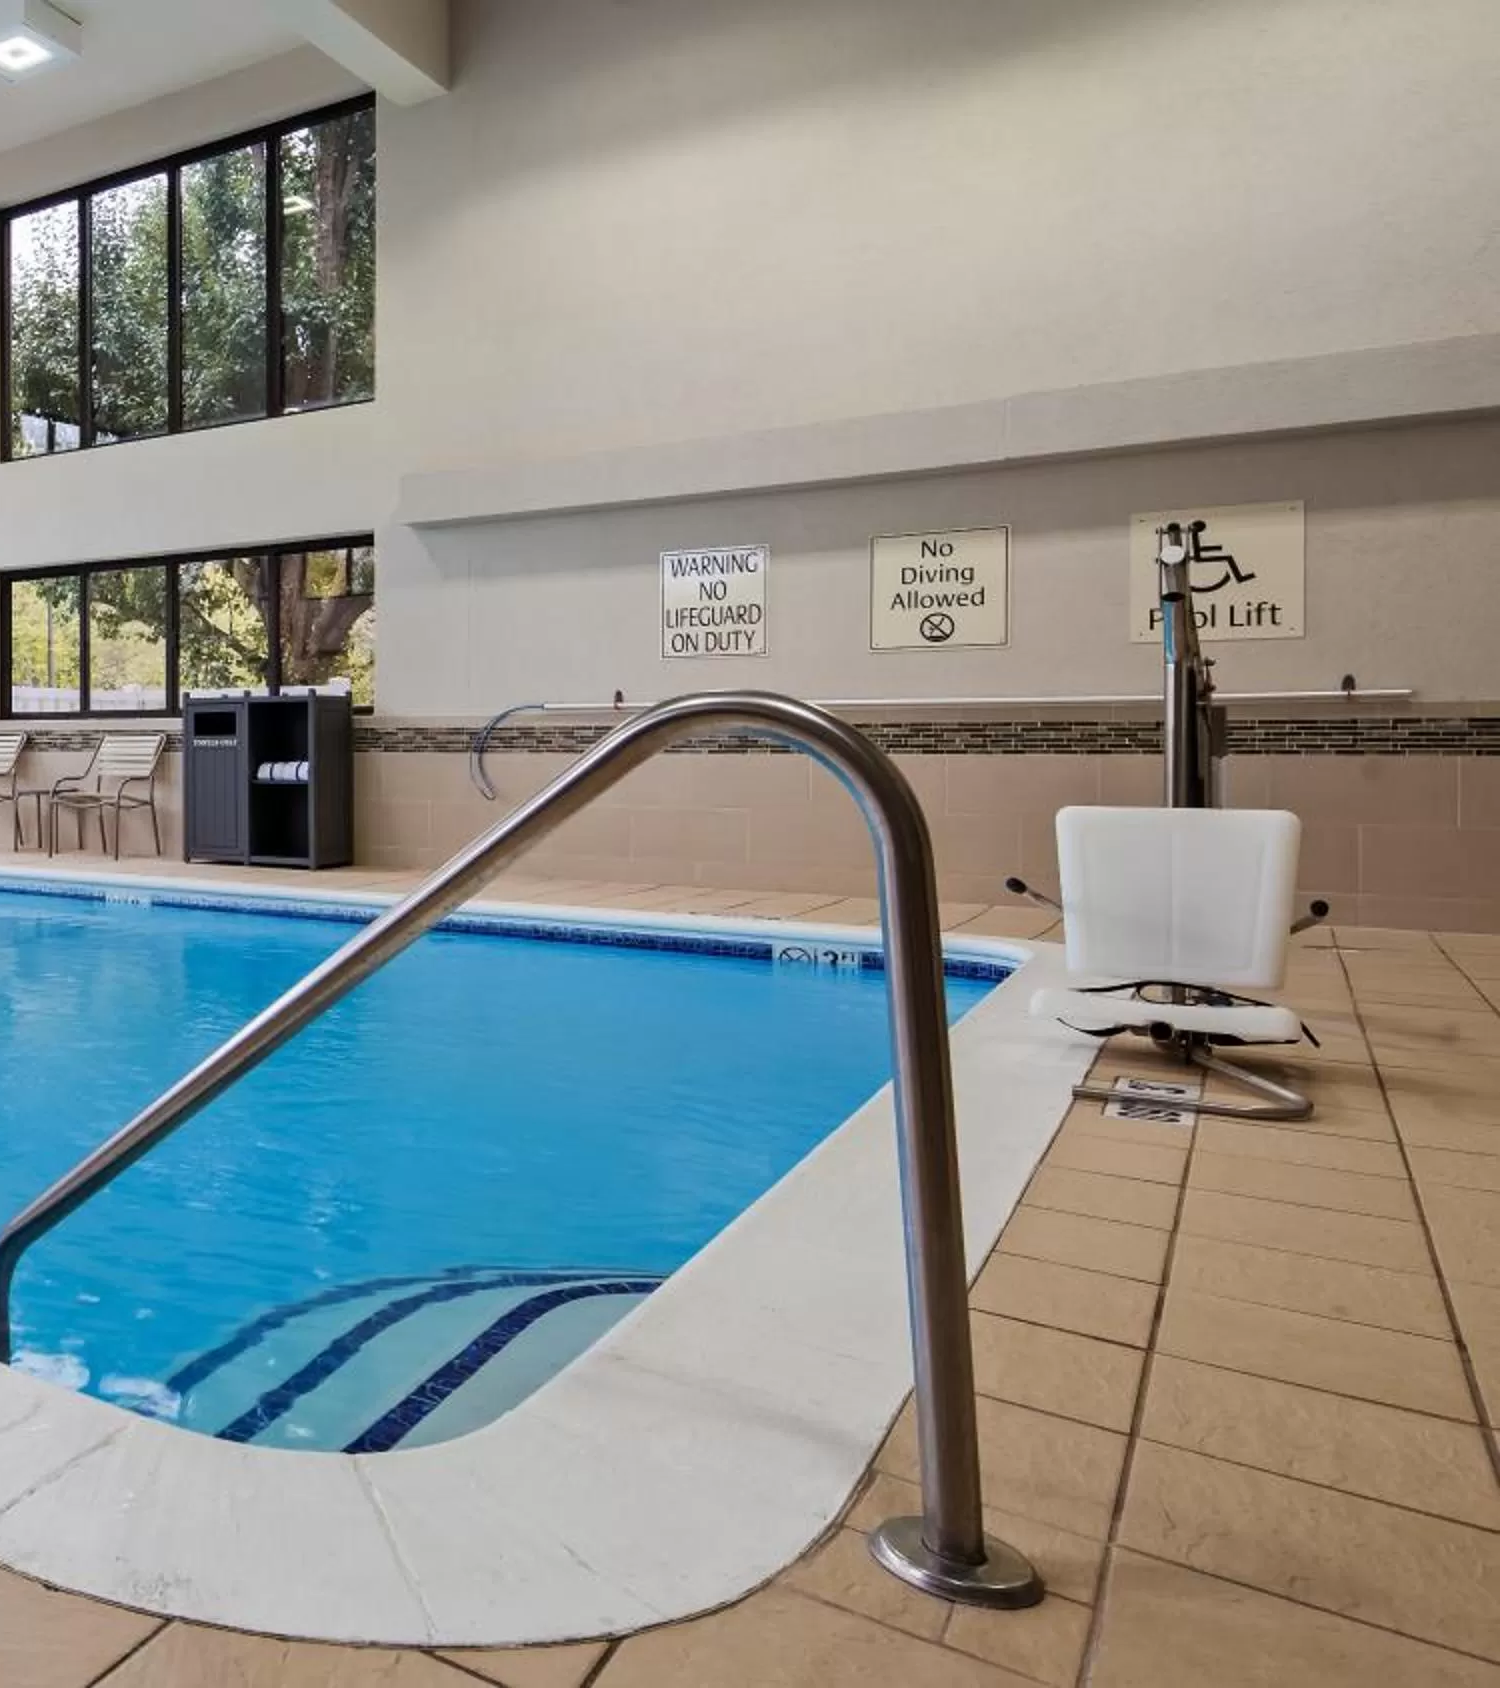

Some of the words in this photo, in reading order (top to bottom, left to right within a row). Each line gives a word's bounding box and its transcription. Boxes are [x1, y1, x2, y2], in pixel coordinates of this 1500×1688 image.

[921, 540, 953, 559] No
[670, 551, 759, 578] WARNING
[901, 563, 975, 586] Diving
[699, 580, 728, 601] NO
[890, 587, 985, 611] Allowed
[665, 604, 762, 629] LIFEGUARD
[1149, 603, 1216, 630] Pol
[1229, 601, 1283, 627] Lift
[671, 633, 699, 653] ON
[704, 630, 756, 653] DUTY
